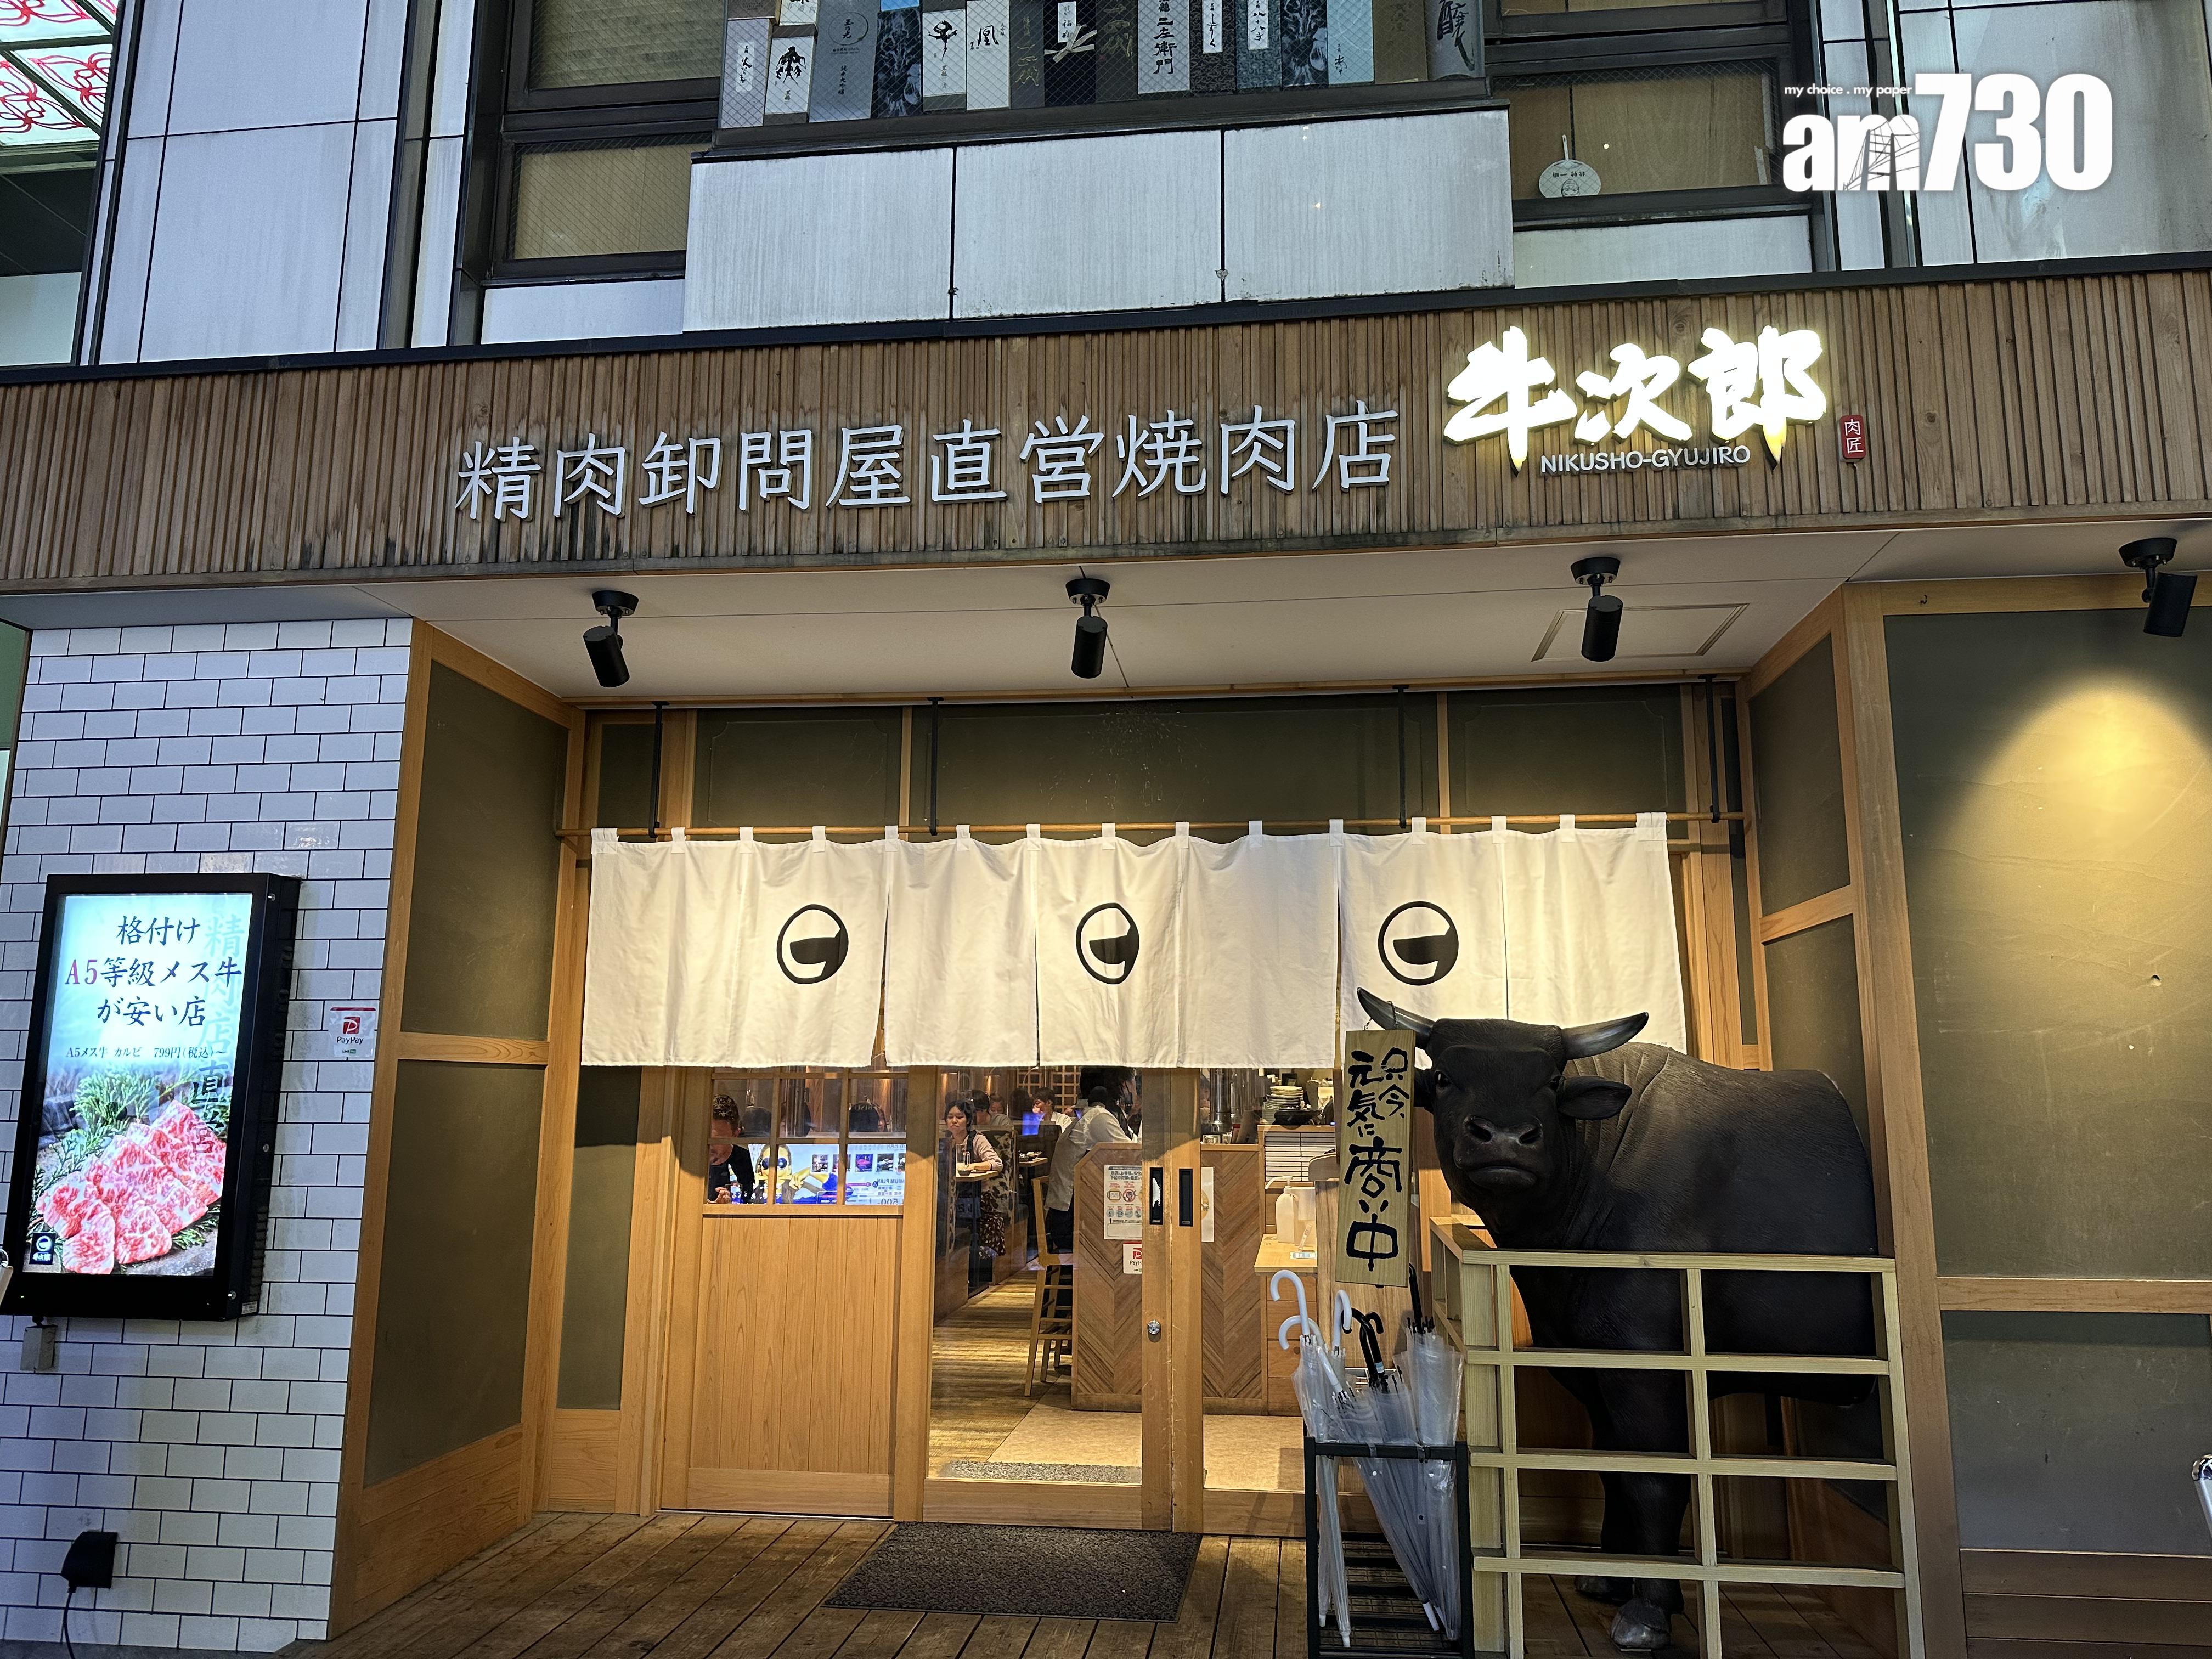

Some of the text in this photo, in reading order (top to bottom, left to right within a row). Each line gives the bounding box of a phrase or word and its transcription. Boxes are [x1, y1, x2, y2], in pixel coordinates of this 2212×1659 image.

[1153, 17, 1177, 75] 二左衛門
[1443, 325, 1827, 473] 牛次郎
[1843, 418, 1863, 455] 肉匠
[455, 400, 1399, 521] 精肉卸問屋直営焼肉店
[1541, 445, 1751, 473] NIKUSHO-GYUJIRO
[116, 915, 201, 946] 格付け
[65, 956, 242, 988] A5等級メス牛
[97, 996, 206, 1027] が安い店
[66, 1046, 108, 1058] A5メス牛
[113, 1047, 143, 1058] カルビ
[337, 1036, 364, 1045] PayPay
[1378, 1047, 1410, 1119] 只今
[1344, 1049, 1403, 1272] 元気に商い中
